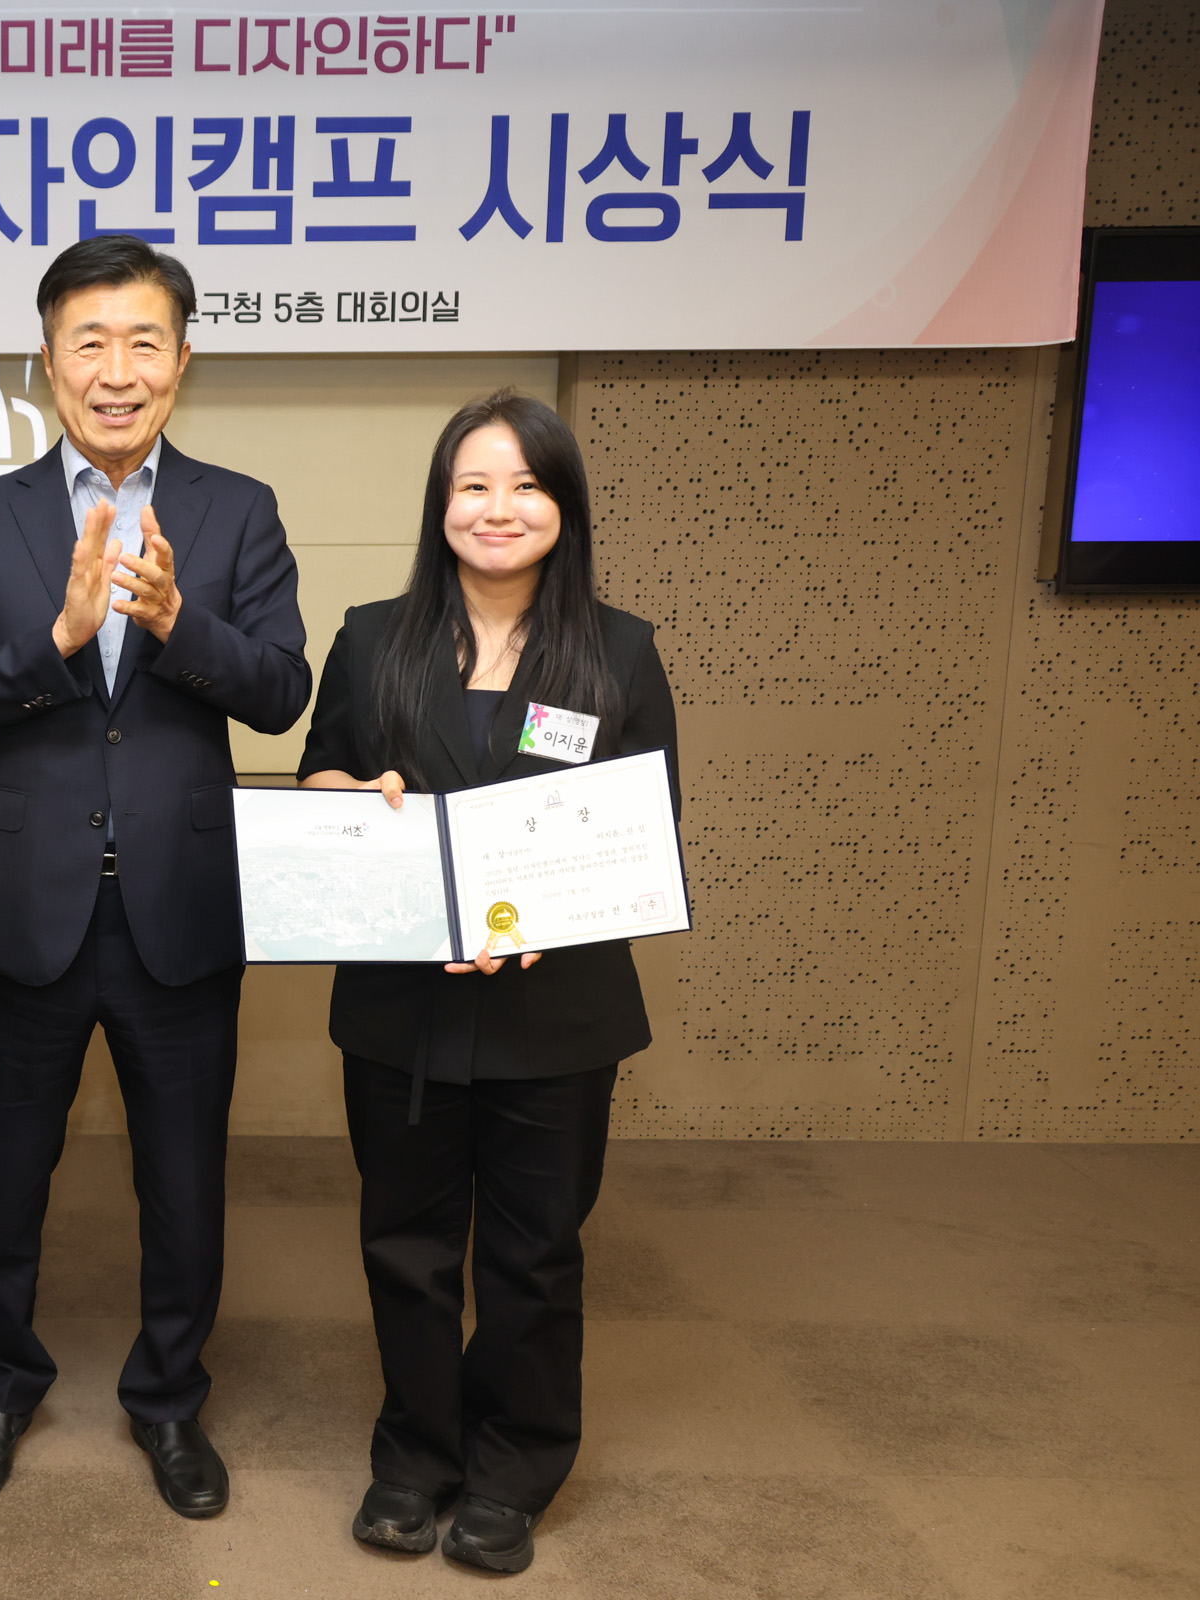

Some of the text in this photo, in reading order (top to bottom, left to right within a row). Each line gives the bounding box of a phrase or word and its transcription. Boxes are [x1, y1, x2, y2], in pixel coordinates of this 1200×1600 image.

[1, 18, 174, 78] 미래를
[195, 15, 516, 76] 디자인하다"
[458, 110, 811, 243] 시상식
[187, 290, 460, 324] 구청 5층 대회의실
[543, 731, 588, 754] 이지윤
[341, 824, 364, 837] 서초
[523, 816, 538, 833] 상
[576, 806, 591, 823] 장
